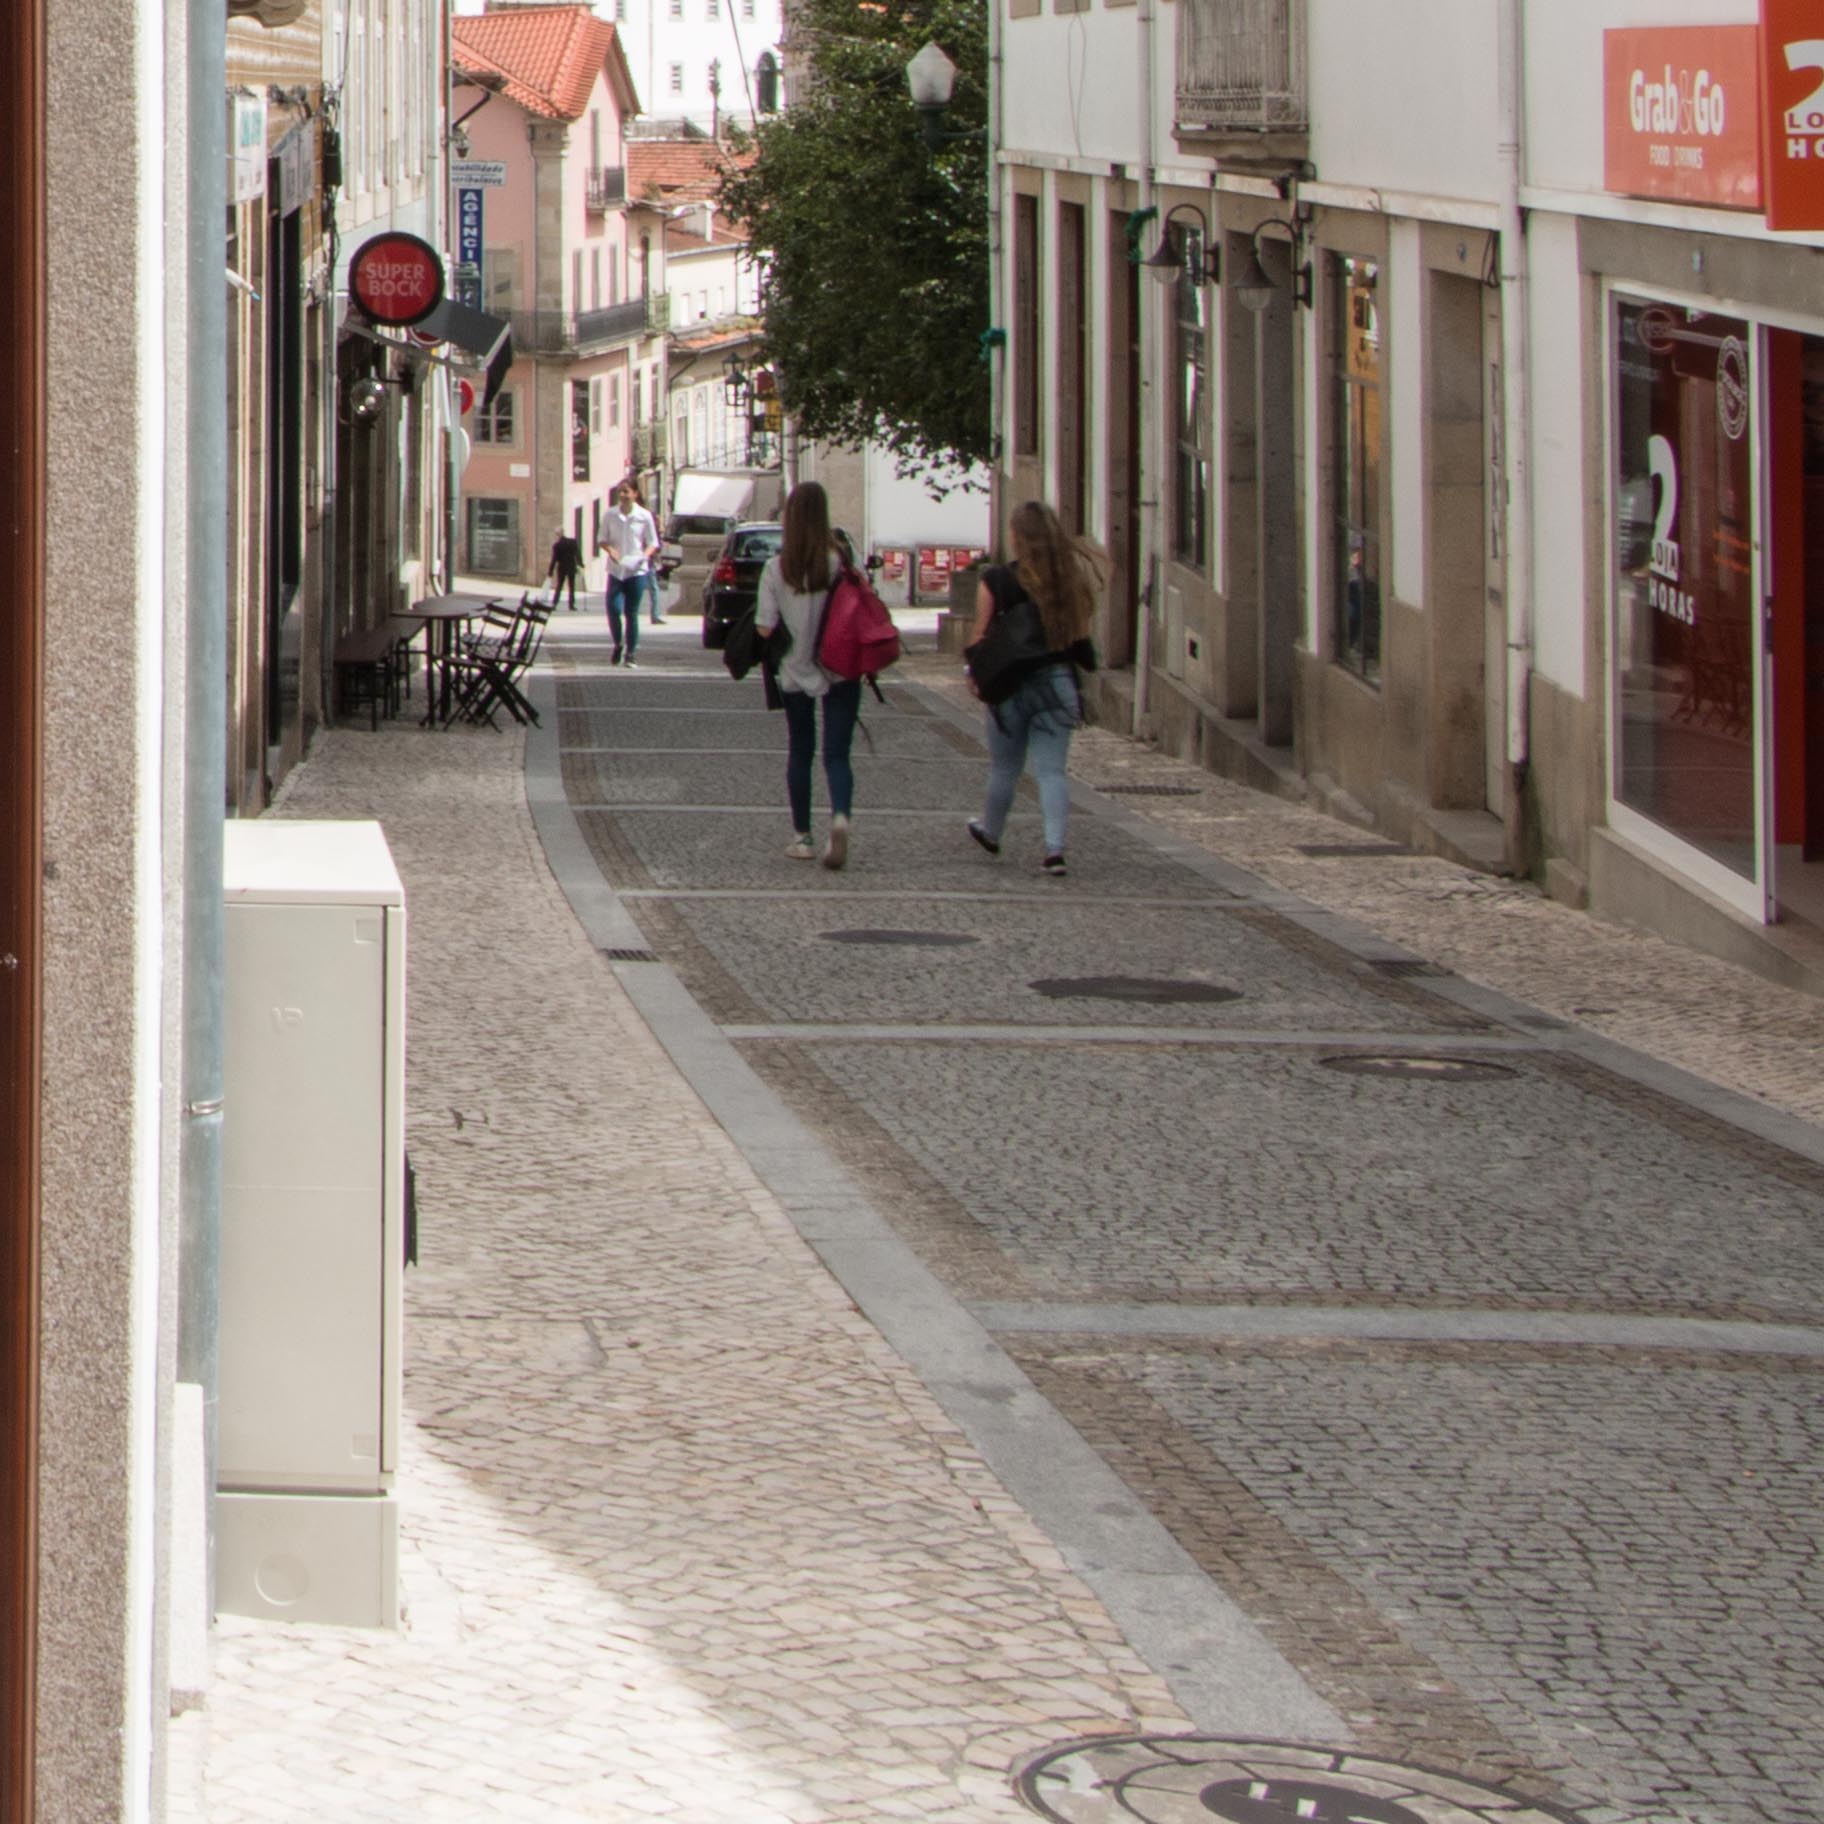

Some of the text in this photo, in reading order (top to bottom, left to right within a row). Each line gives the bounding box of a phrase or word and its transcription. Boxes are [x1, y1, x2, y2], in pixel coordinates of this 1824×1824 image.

[1630, 63, 1724, 137] Grab&Go
[1649, 143, 1703, 170] FOOD DRINKS
[366, 262, 424, 279] SUPER
[369, 280, 422, 296] BOCK
[1648, 577, 1696, 625] HORAS
